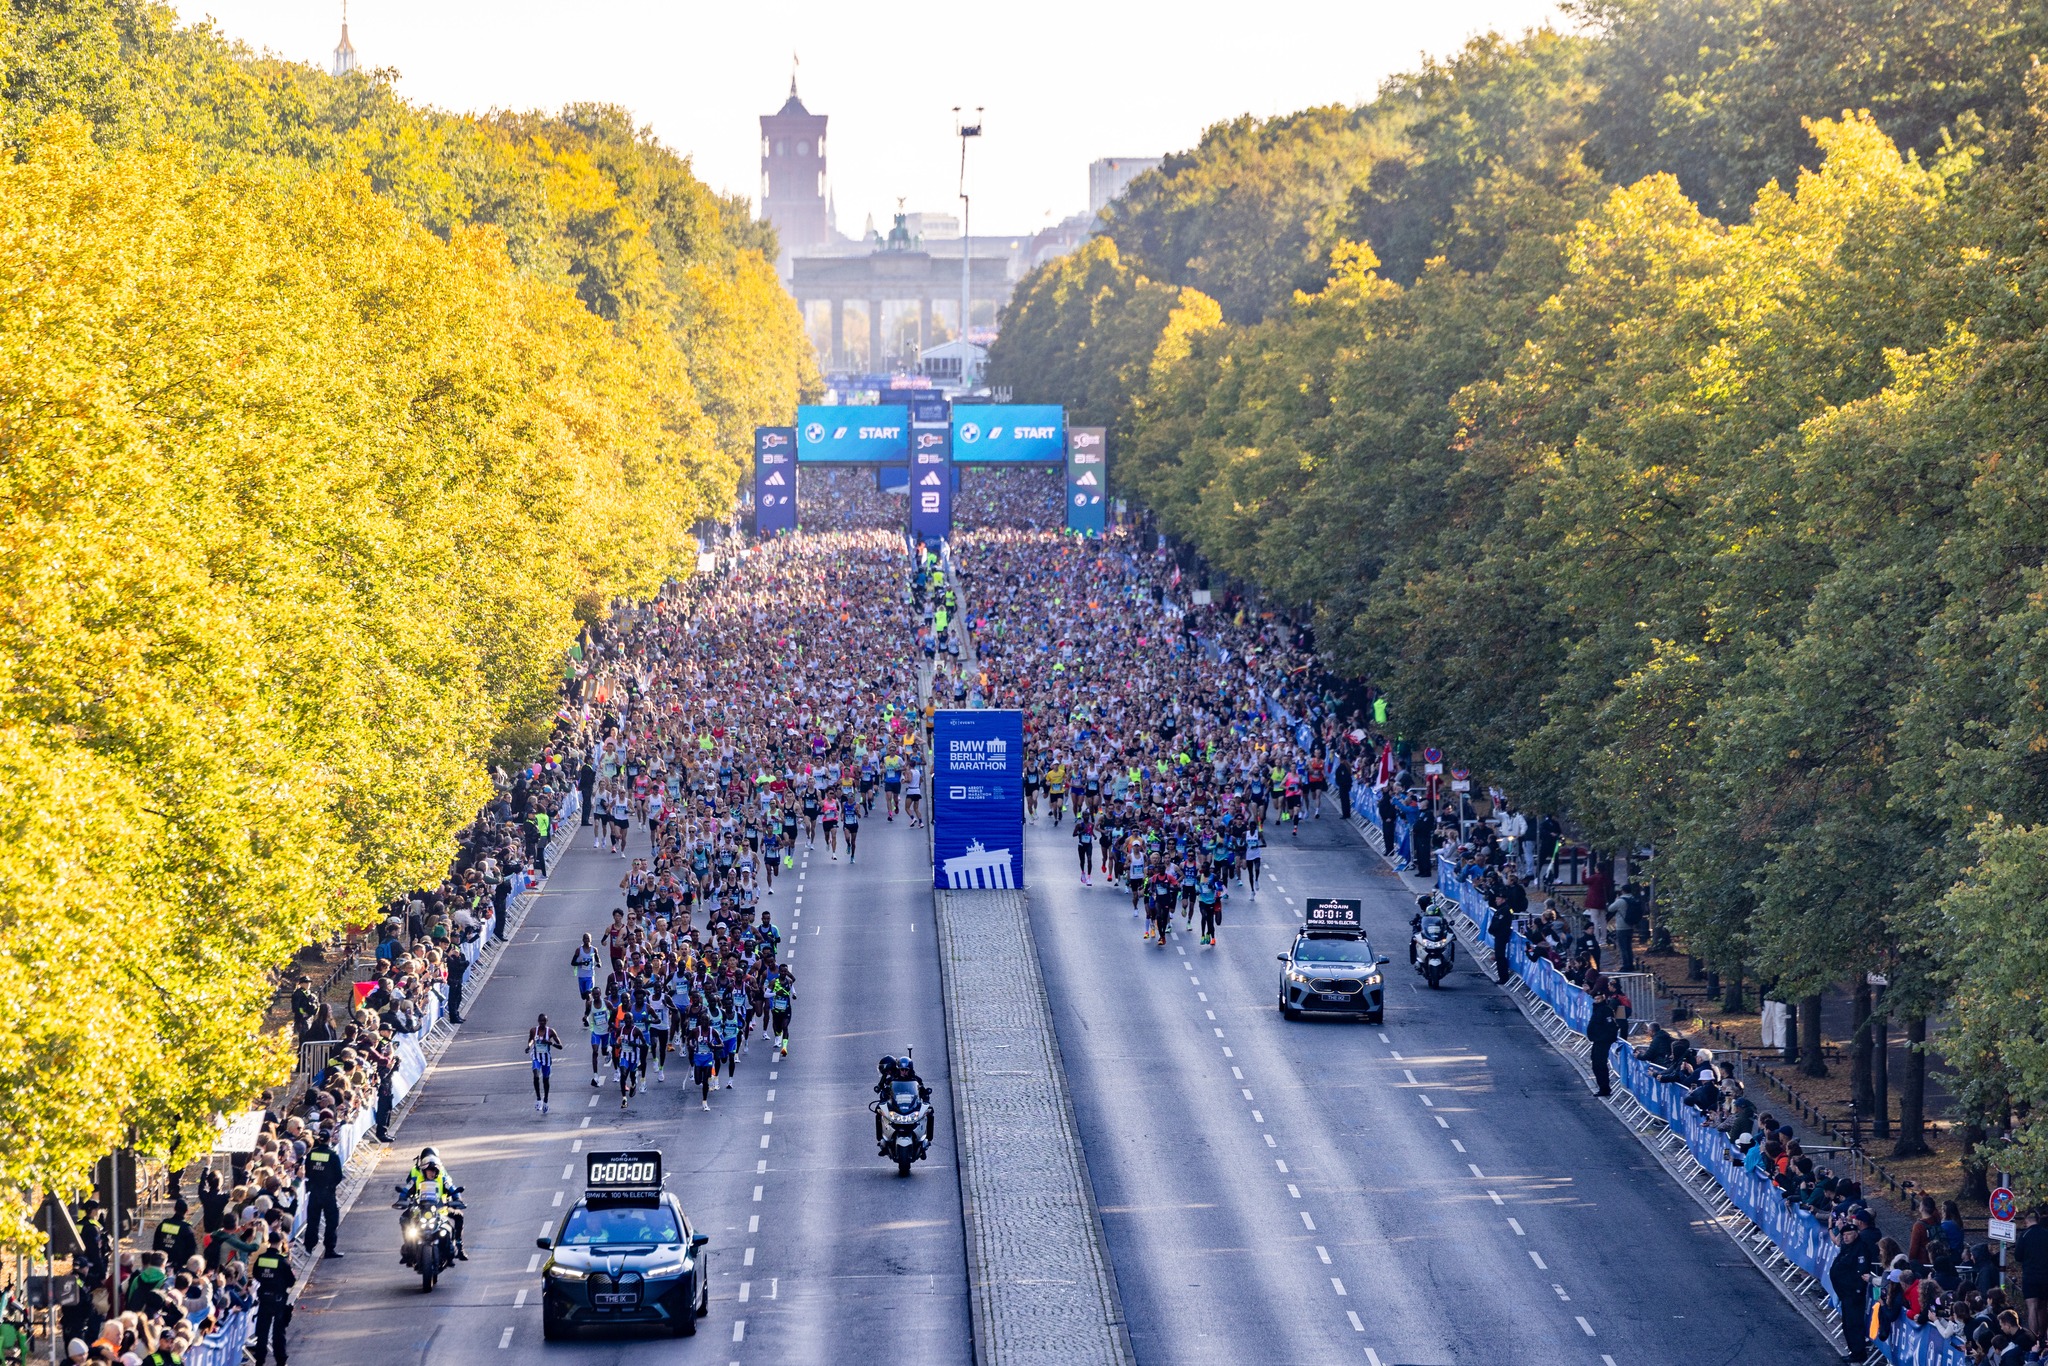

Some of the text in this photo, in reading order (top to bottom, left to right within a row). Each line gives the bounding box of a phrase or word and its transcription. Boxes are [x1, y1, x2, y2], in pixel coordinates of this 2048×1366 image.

[859, 427, 901, 440] START
[1014, 427, 1056, 440] START
[950, 740, 985, 752] BMW
[950, 752, 985, 761] BERLIN
[950, 761, 1006, 770] MARATHON
[590, 1163, 655, 1182] 0:00:00
